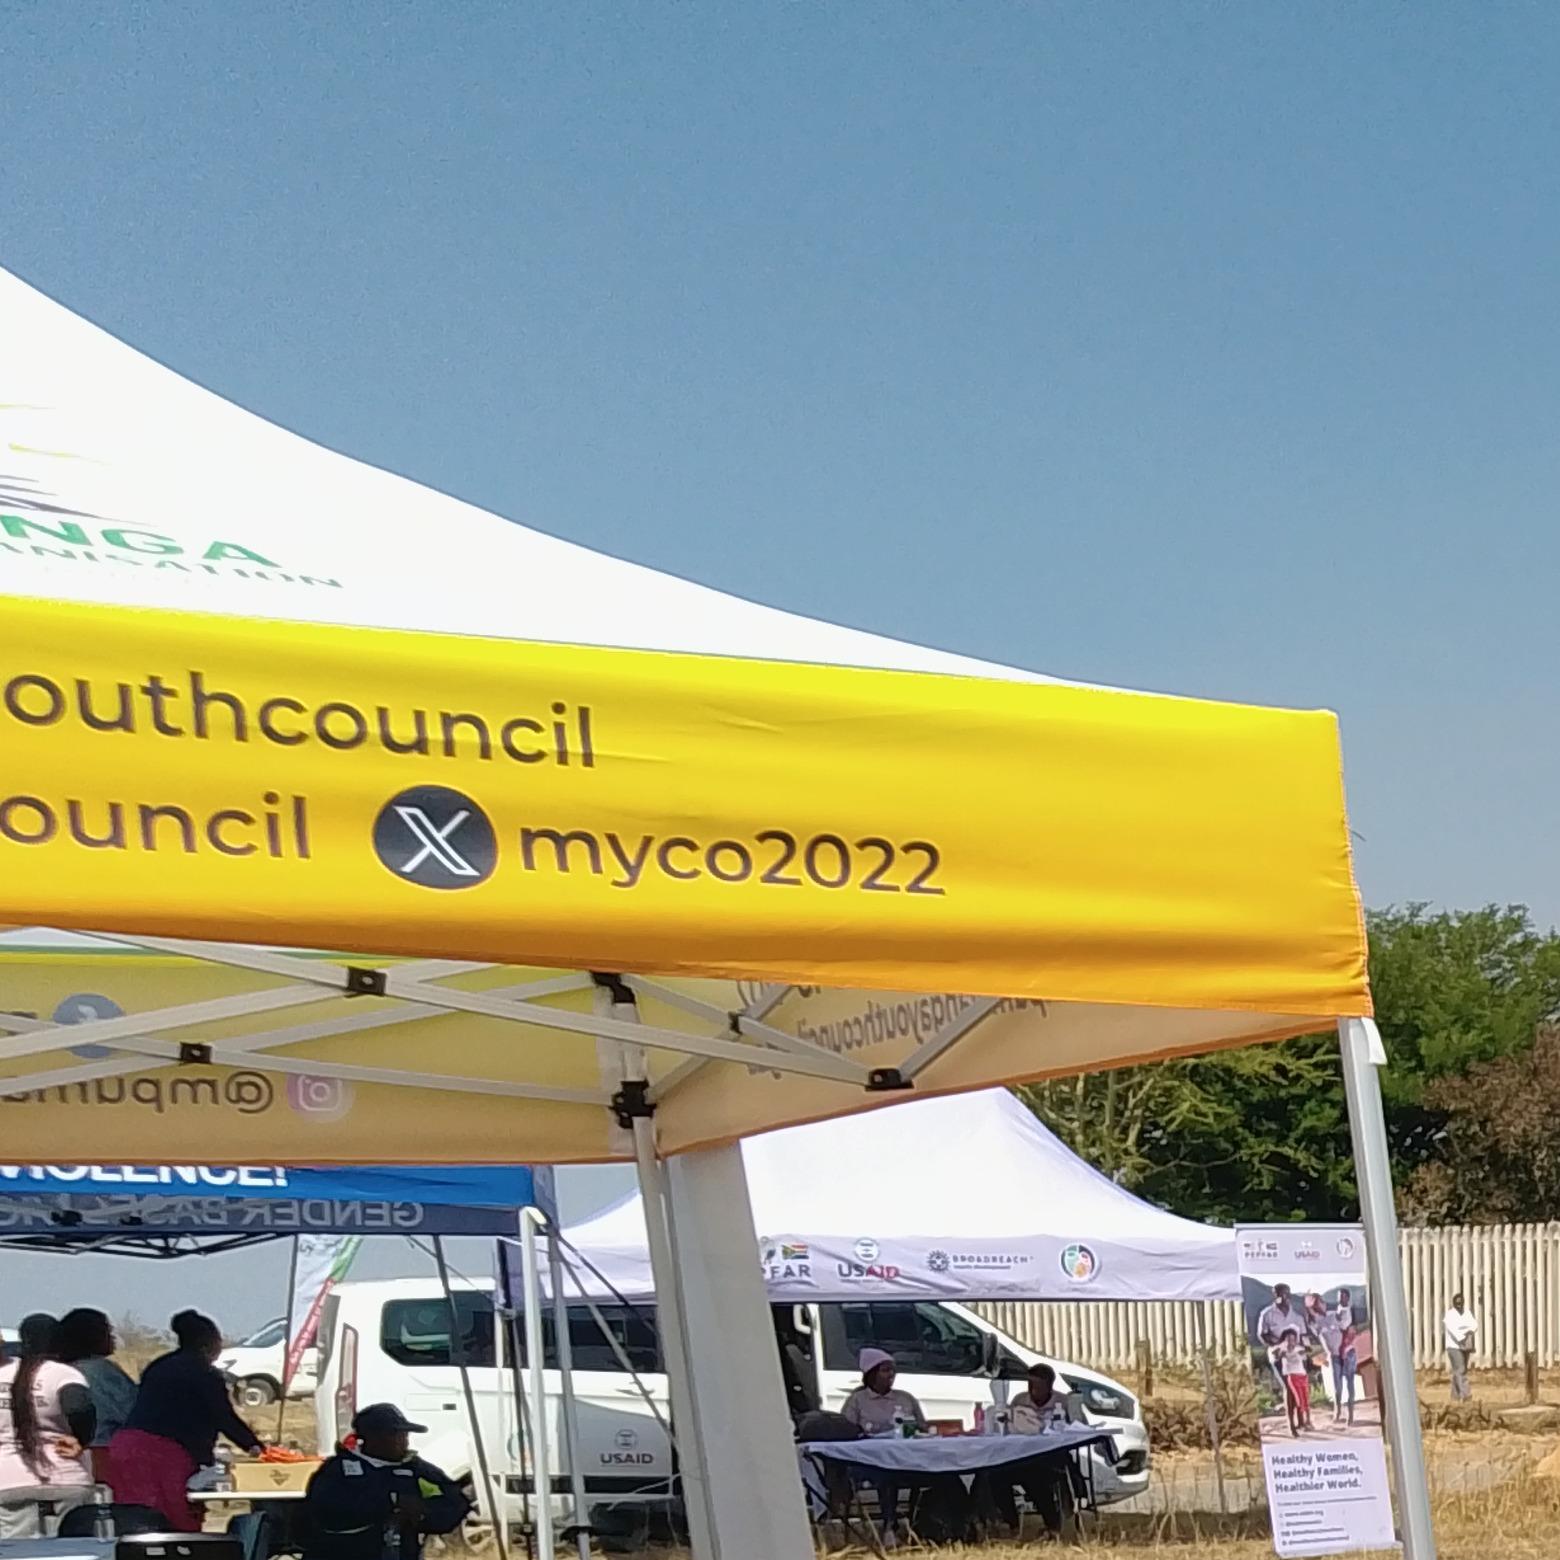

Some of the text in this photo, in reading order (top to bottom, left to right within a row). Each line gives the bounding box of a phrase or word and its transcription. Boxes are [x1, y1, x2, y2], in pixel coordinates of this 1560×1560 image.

[0, 514, 282, 568] NGA
[3, 671, 596, 768] outhcouncil
[0, 791, 311, 859] ouncil
[520, 825, 946, 895] myco2022
[761, 1264, 900, 1280] FAR USAID
[601, 1453, 653, 1463] USAID
[1271, 1452, 1359, 1466] Healthy Women,
[1273, 1465, 1363, 1480] Healthy Families,
[1275, 1478, 1361, 1493] Healthier World.
